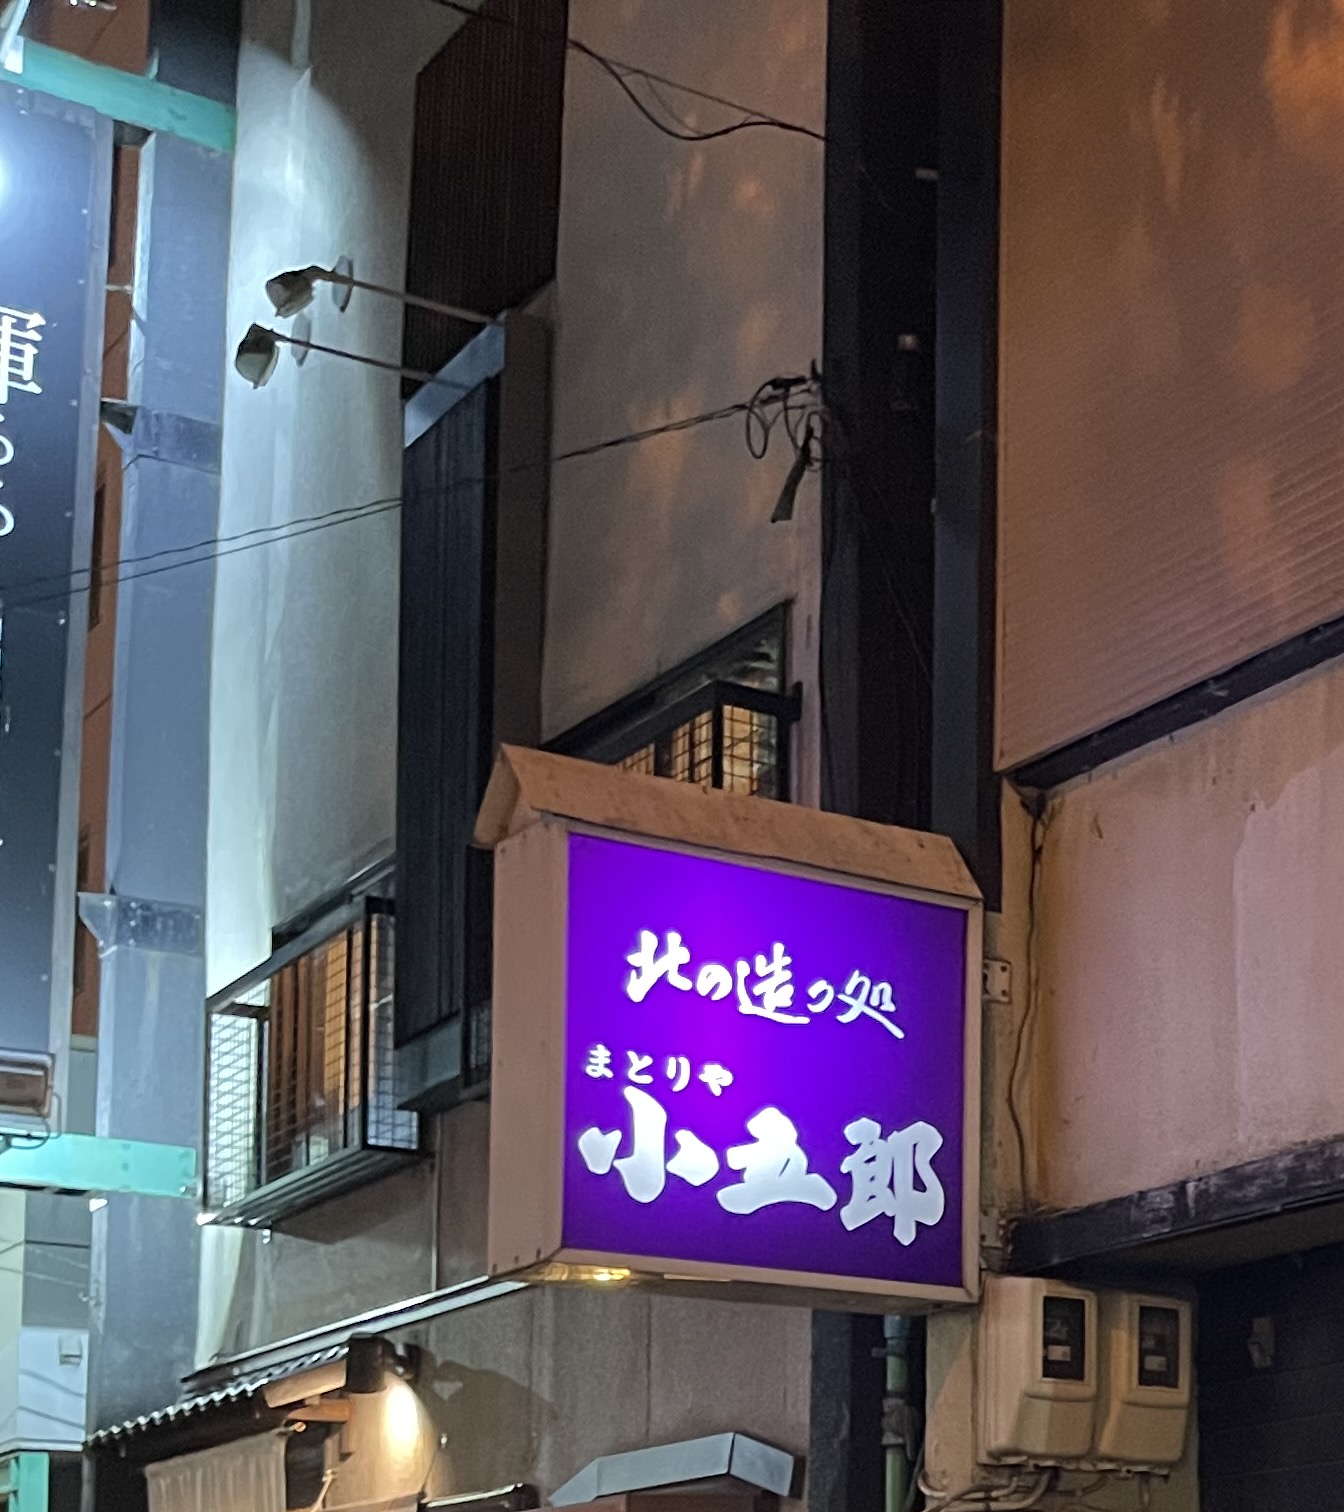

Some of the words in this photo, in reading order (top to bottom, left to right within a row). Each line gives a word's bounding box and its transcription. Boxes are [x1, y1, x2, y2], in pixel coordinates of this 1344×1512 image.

[626, 929, 904, 1038] 北の造り処
[584, 1045, 733, 1095] まとりや
[579, 1086, 945, 1246] 小五郎
